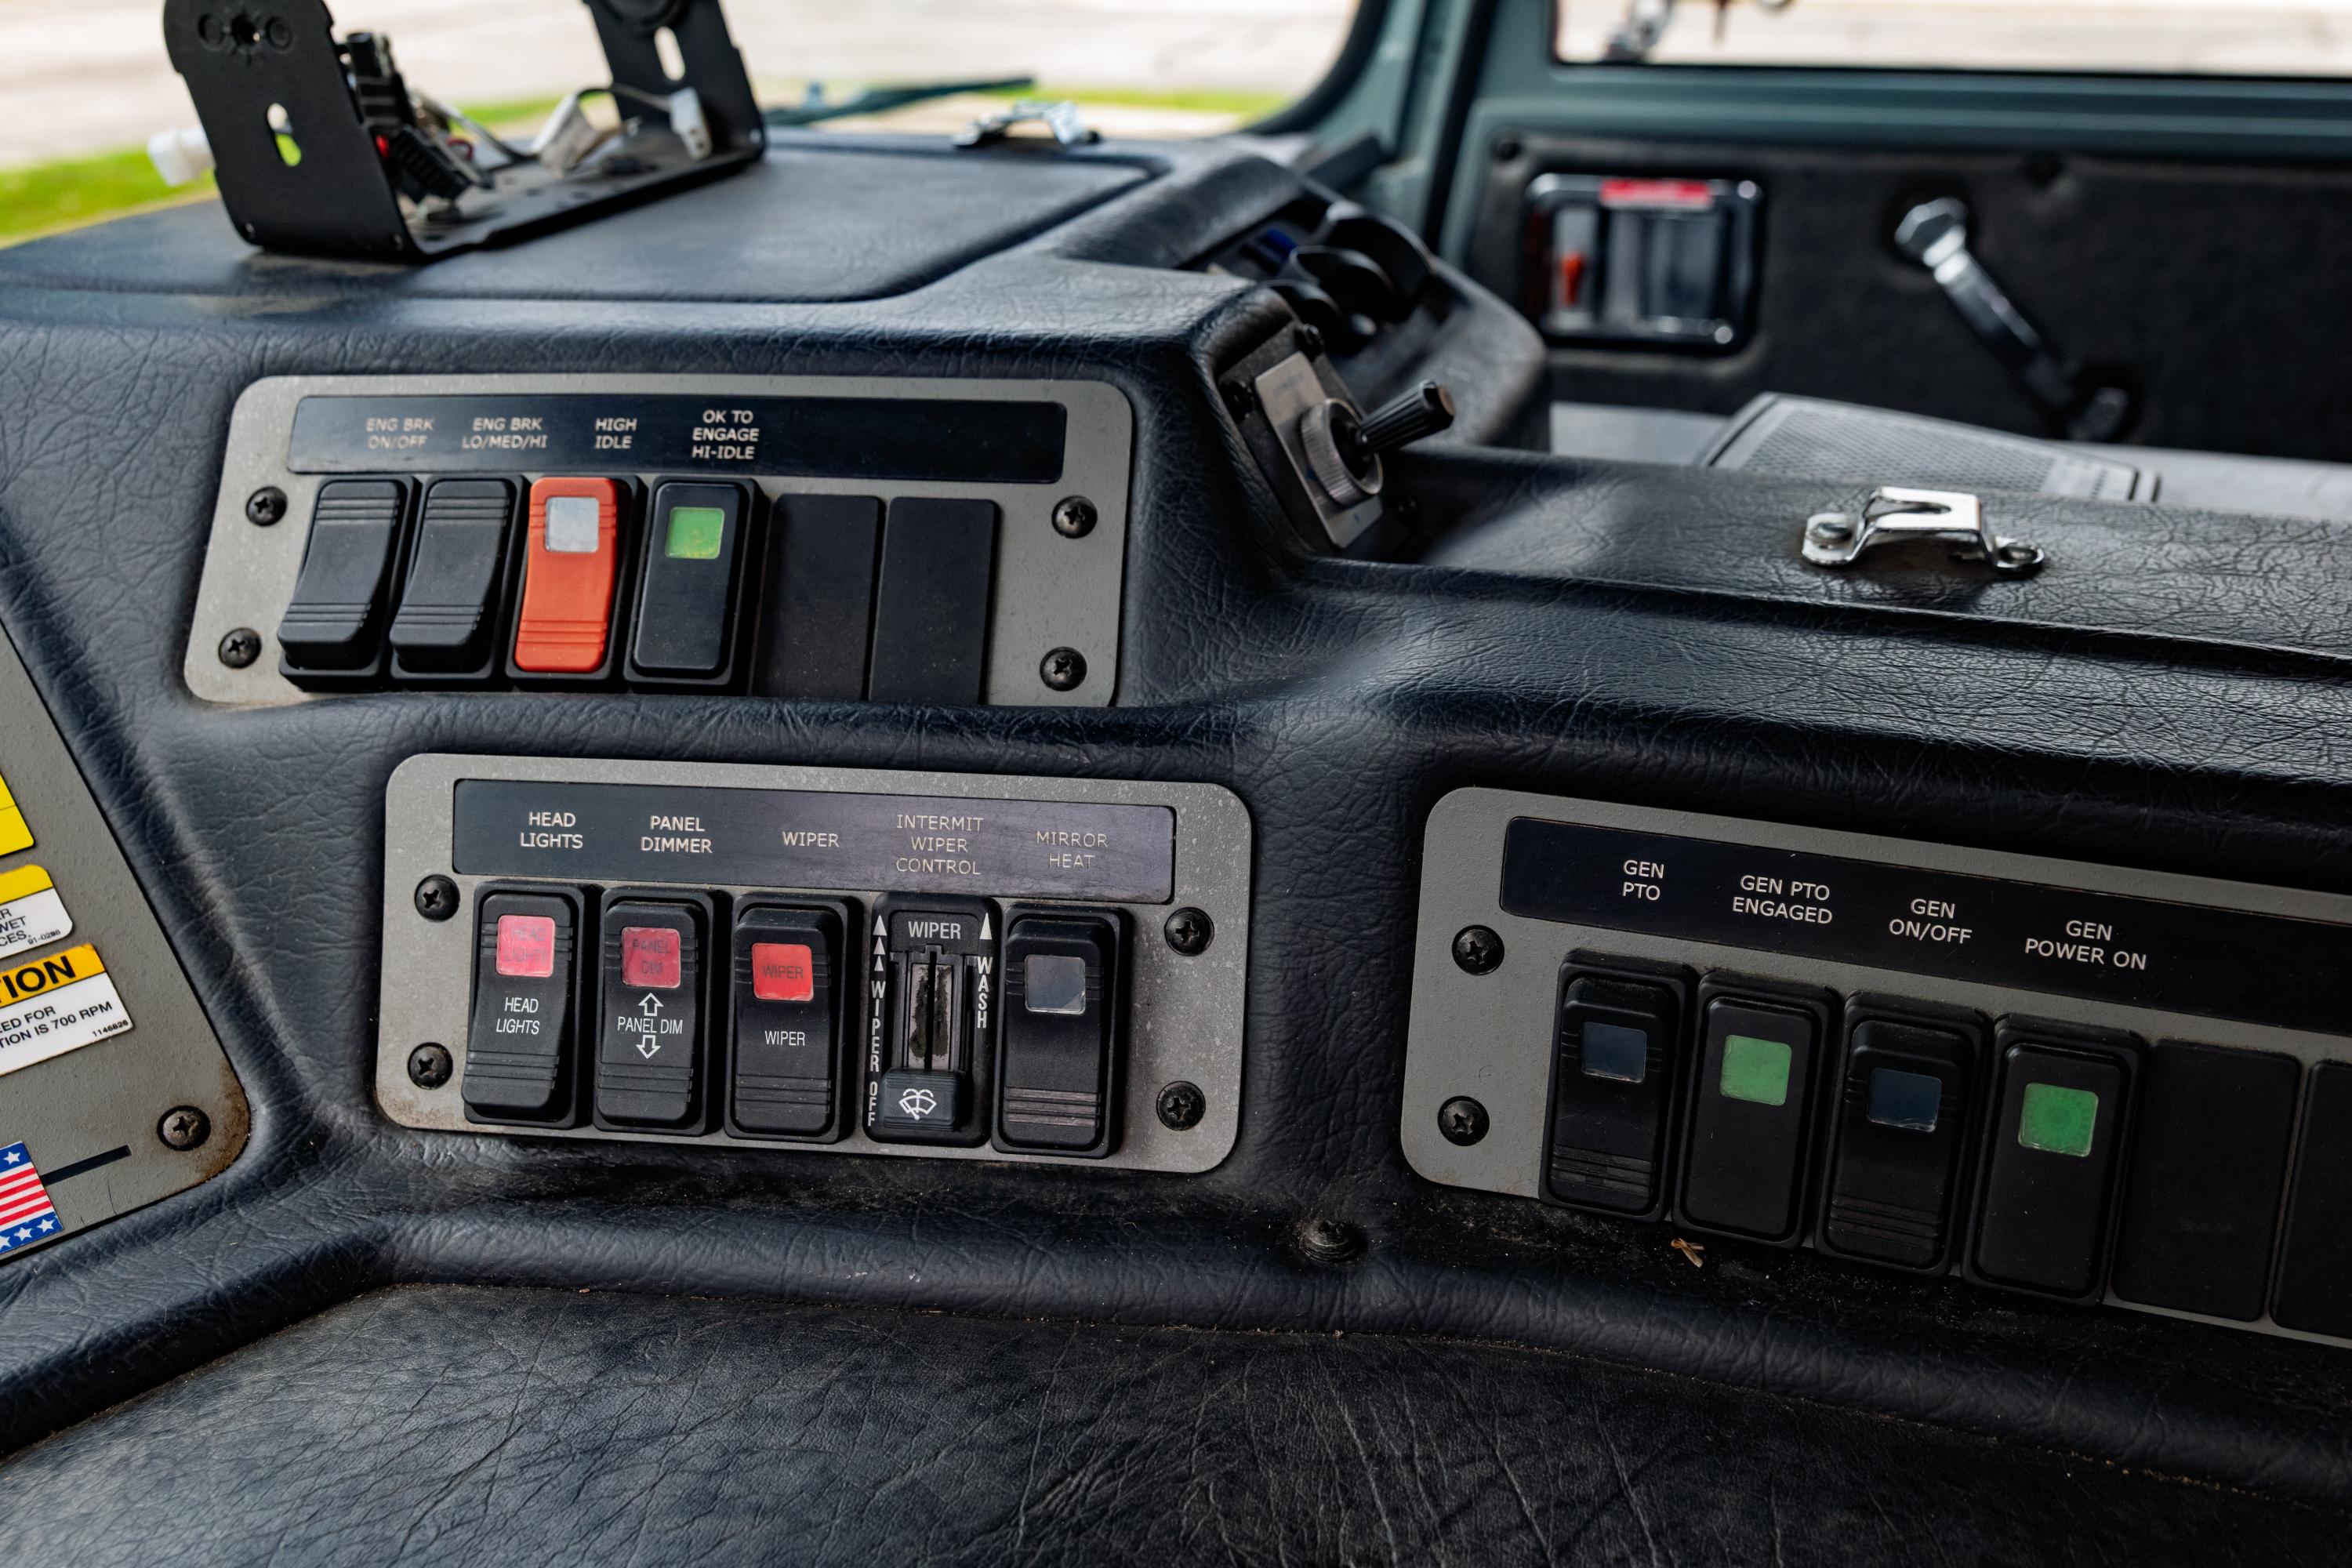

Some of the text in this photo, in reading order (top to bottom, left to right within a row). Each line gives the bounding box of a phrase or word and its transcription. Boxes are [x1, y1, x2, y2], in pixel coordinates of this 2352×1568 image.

[366, 417, 434, 432] ENG BRK
[473, 417, 543, 431] ENG BRK
[595, 418, 637, 431] HIGH
[703, 409, 753, 423] OK TO
[368, 435, 427, 449] ON/OFF
[462, 435, 548, 449] LO/MED/HI
[595, 435, 633, 449] IDLE
[692, 427, 760, 441] ENGAGE
[691, 445, 755, 459] HI-IDLE
[528, 811, 576, 827] HEAD
[650, 815, 705, 832] PANEL
[896, 814, 985, 832] INTERMIT
[520, 832, 583, 849] LIGHTS
[641, 837, 713, 853] DIMMER
[782, 830, 840, 848] WIPER
[911, 836, 968, 853] WIPER
[1036, 831, 1108, 848] MIRROR
[895, 858, 982, 875] CONTROL
[1049, 853, 1095, 868] HEAT
[1623, 859, 1664, 879] GEN
[1622, 881, 1661, 901] PTO
[1740, 875, 1830, 901] GEN PTO
[1732, 896, 1832, 924] ENGAGED
[1910, 898, 1955, 920] GEN
[908, 920, 961, 939] WIPER
[1889, 919, 1973, 945] ON/OFF
[2065, 920, 2113, 941] GEN
[633, 938, 671, 953] PANEL
[2024, 938, 2147, 971] POWER ON
[763, 965, 804, 979] WIPER
[977, 956, 993, 1029] WASH
[504, 996, 539, 1014] HEAD
[24, 1006, 56, 1023] FOR
[34, 1024, 49, 1036] IS
[51, 1014, 77, 1029] 700
[79, 1001, 113, 1019] RPM
[495, 1018, 539, 1035] LIGHTS
[617, 1016, 683, 1034] PANEL DIM
[764, 1030, 806, 1047] WIPER
[868, 980, 886, 1127] WIPER OFF
